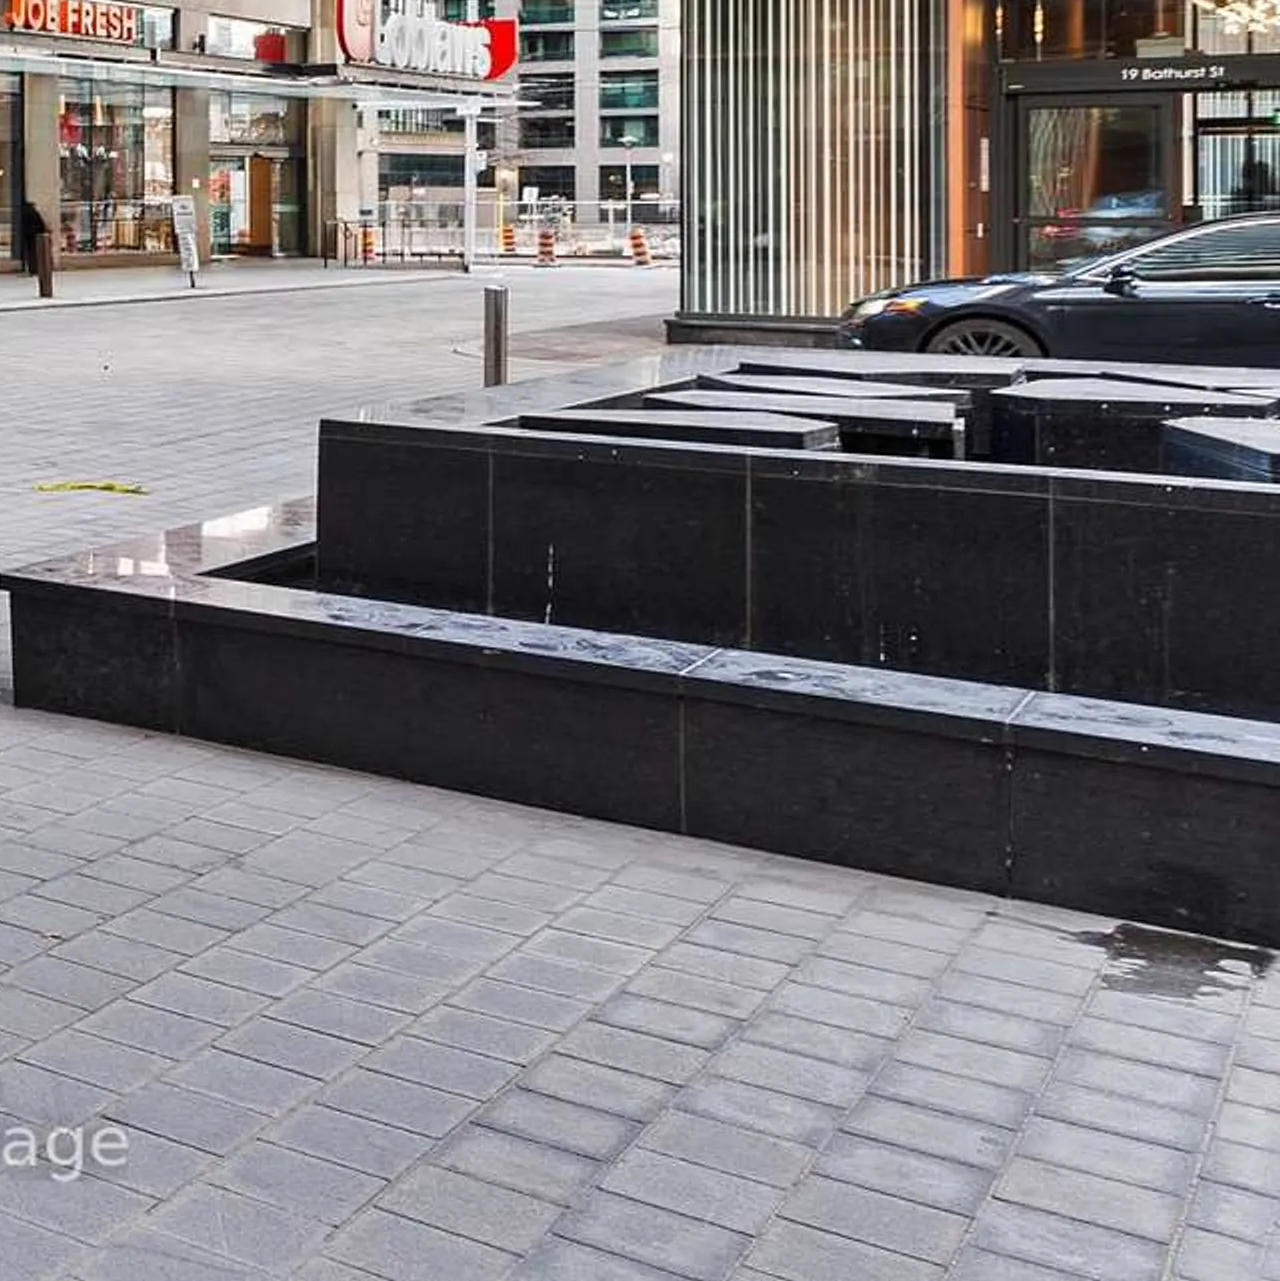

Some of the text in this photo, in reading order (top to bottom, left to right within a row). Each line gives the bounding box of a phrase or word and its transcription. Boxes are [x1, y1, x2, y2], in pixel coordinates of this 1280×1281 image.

[66, 0, 137, 42] FRESH
[1121, 65, 1224, 80] 19 Bathurst St
